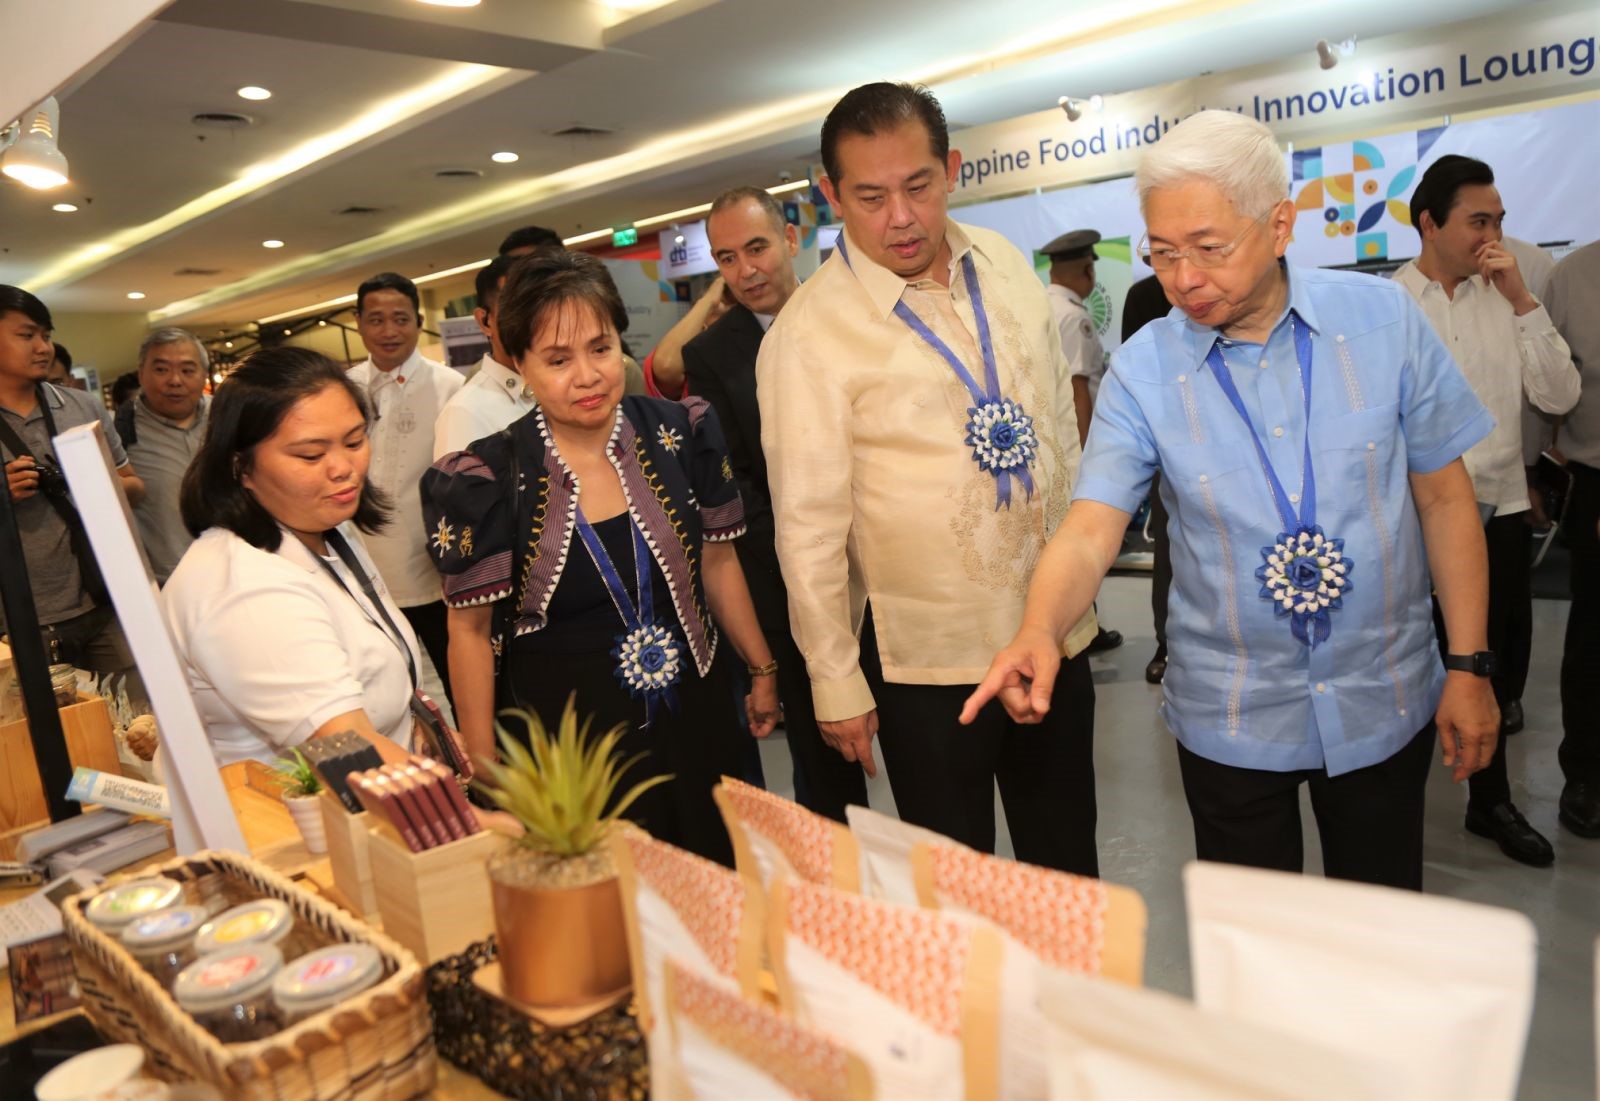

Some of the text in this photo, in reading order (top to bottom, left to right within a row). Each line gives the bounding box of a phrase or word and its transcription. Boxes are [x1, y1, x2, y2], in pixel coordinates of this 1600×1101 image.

[958, 149, 1031, 188] ppine
[1039, 127, 1106, 165] Food
[1253, 66, 1446, 123] Innovation
[1459, 37, 1600, 87] Loung
